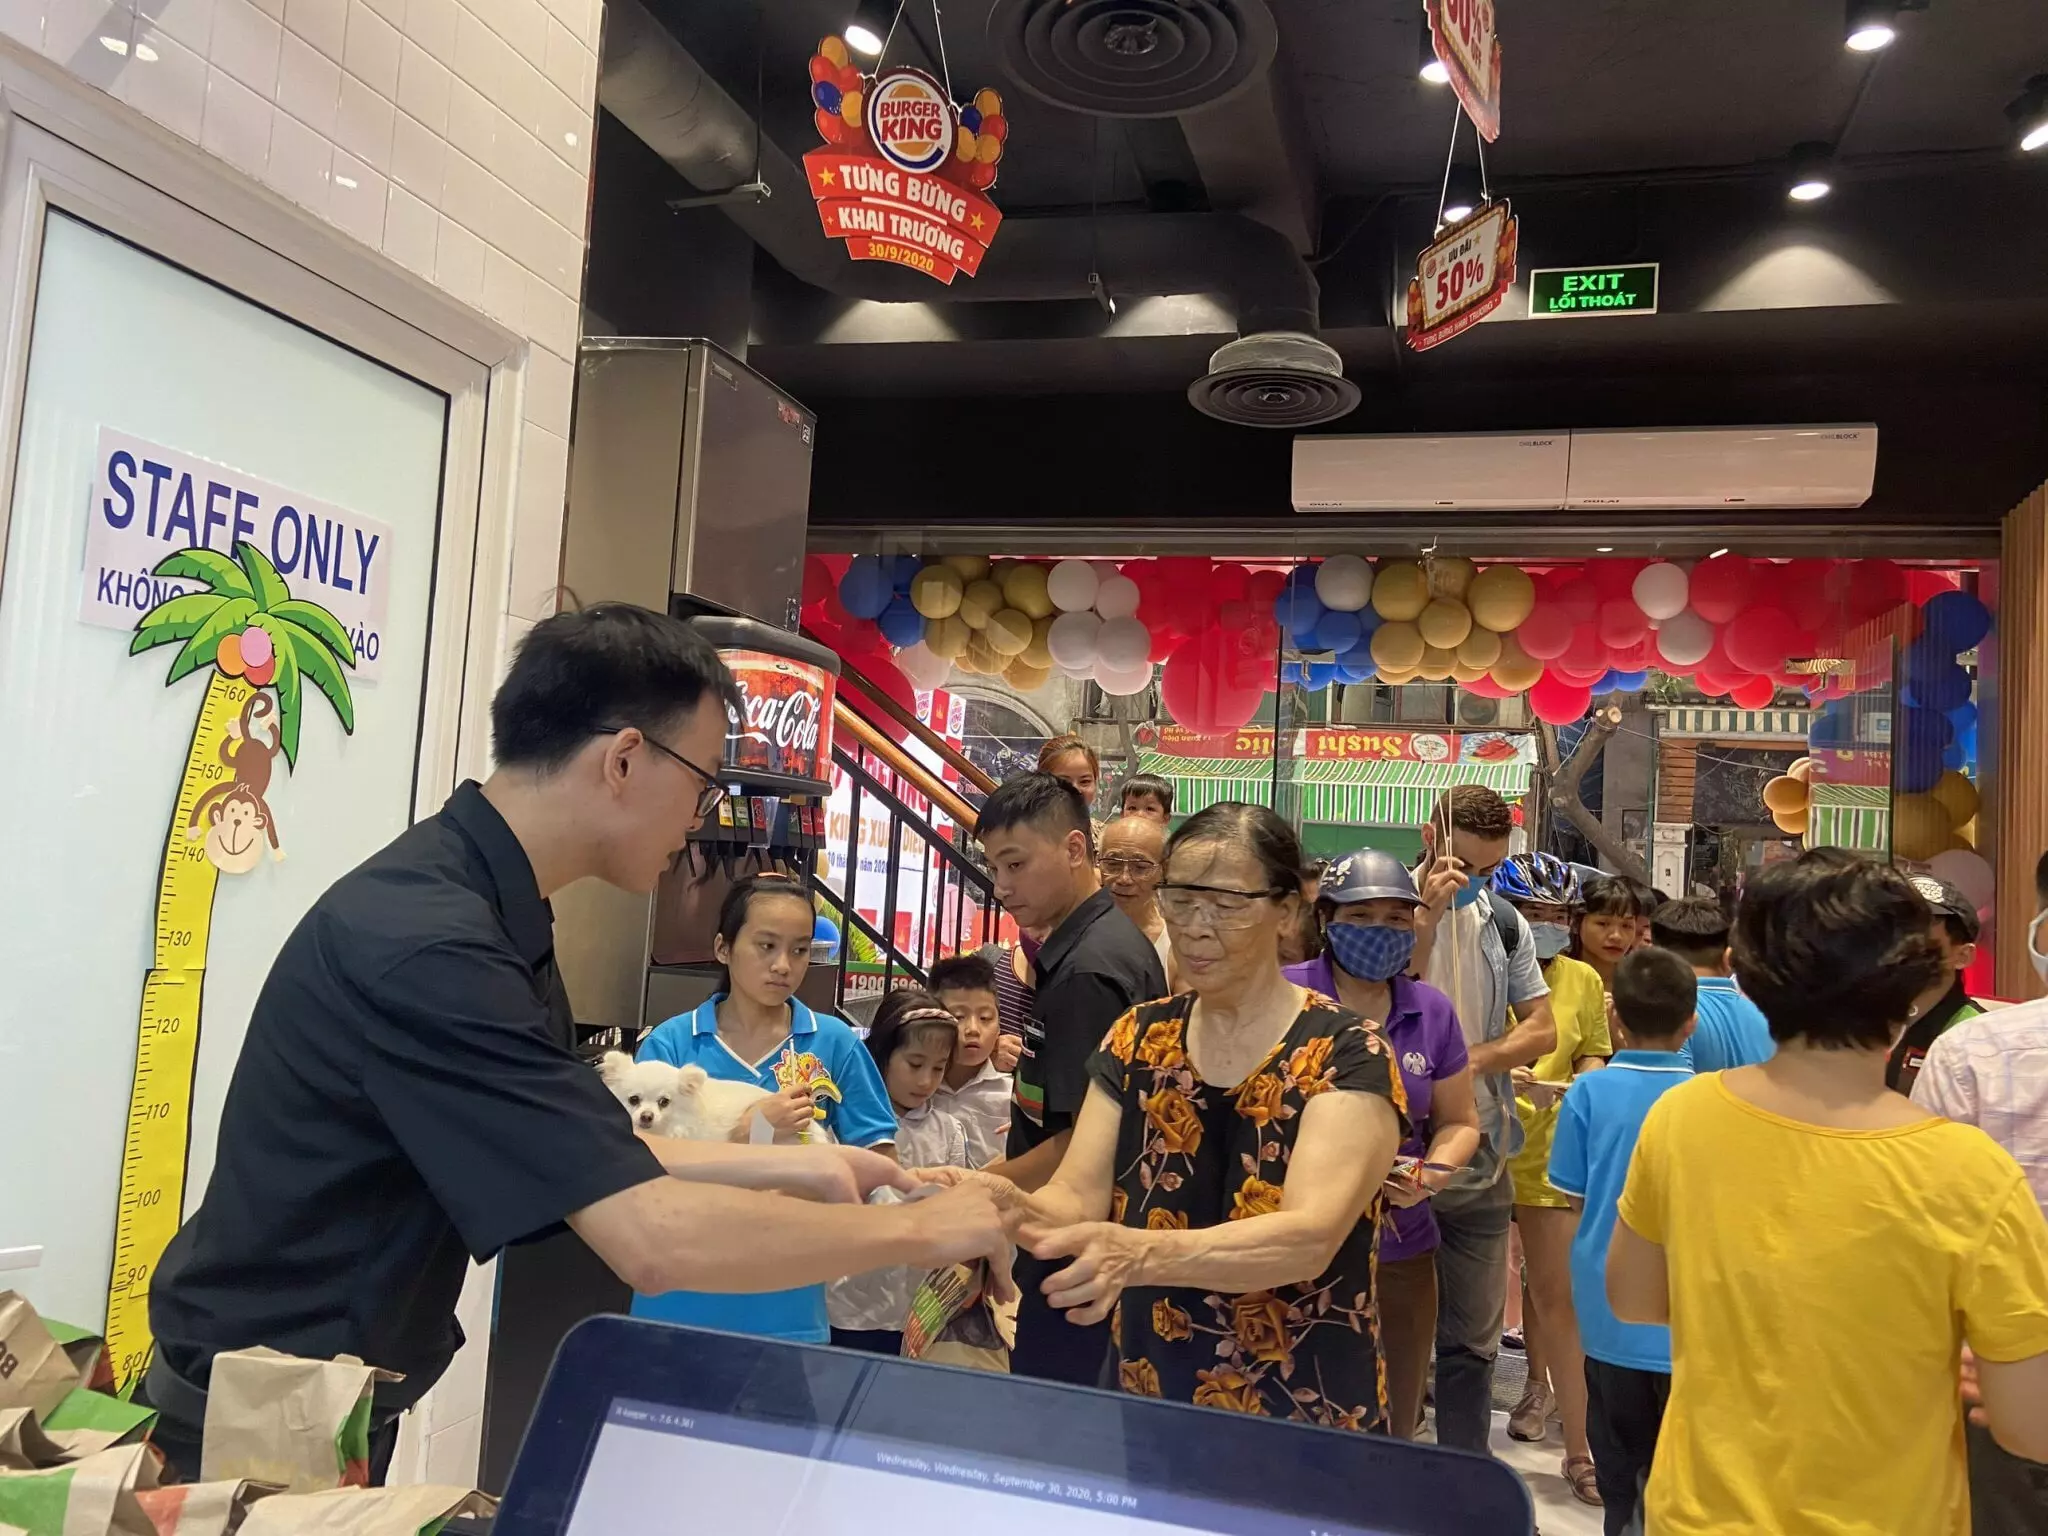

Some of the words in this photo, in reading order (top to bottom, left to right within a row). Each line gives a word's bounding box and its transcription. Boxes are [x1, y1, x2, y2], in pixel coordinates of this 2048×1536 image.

[880, 101, 941, 119] BURGER
[881, 118, 942, 142] KING
[839, 162, 900, 197] TƯNG
[907, 177, 967, 223] BỪNG
[838, 207, 885, 233] KHAI
[889, 214, 965, 261] TRƯƠNG
[868, 242, 934, 272] 30/9/2020
[1436, 253, 1484, 309] 50%
[1563, 273, 1625, 291] EXIT
[1549, 292, 1576, 309] LỐI
[1578, 292, 1637, 308] THOÁT
[103, 450, 259, 559] STAFF
[271, 505, 380, 595] ONLY
[223, 685, 246, 702] 160
[1318, 735, 1402, 757] Sushi
[201, 763, 223, 780] 150
[183, 846, 205, 863] 140
[168, 929, 191, 947] 130
[849, 974, 885, 991] 1900
[156, 1018, 180, 1034] 120
[146, 1102, 170, 1120] 110
[137, 1188, 161, 1208] 100
[127, 1264, 147, 1284] 90
[122, 1351, 142, 1370] 80
[876, 1452, 931, 1472] Wednesday,
[934, 1462, 990, 1484] Wednesday,
[992, 1472, 1046, 1491] September
[1048, 1482, 1062, 1496] 30,
[1066, 1486, 1093, 1503] 2020,
[1096, 1490, 1119, 1506] 5:00
[1121, 1495, 1138, 1509] PM
